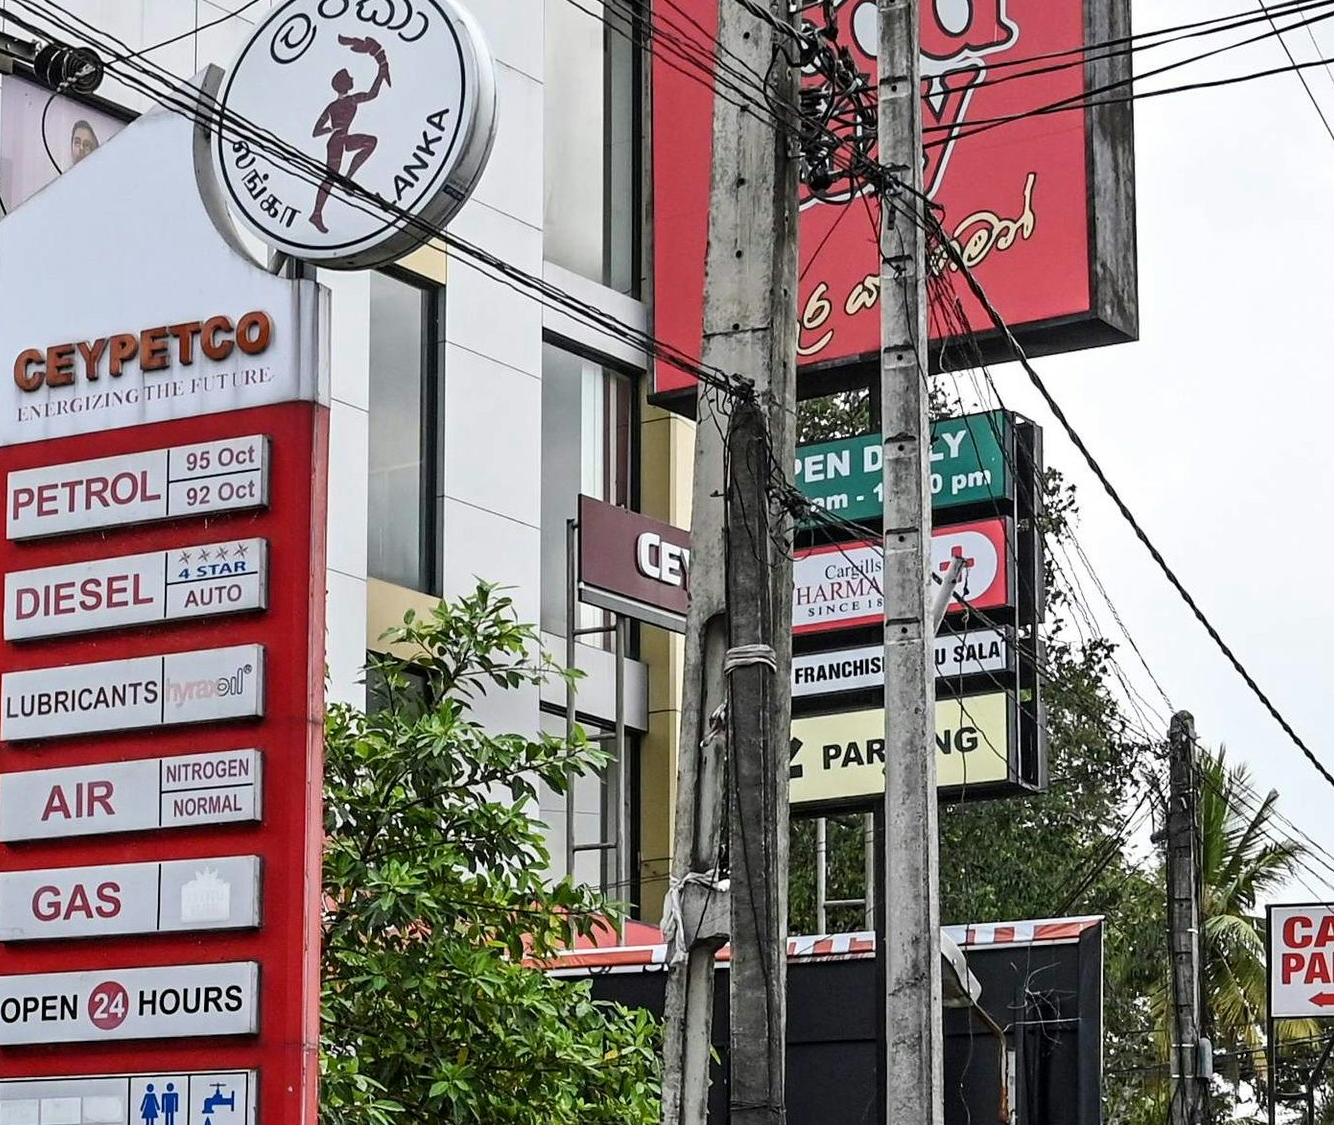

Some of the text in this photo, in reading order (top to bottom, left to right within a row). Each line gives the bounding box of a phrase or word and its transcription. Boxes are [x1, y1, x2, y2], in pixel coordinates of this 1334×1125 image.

[14, 310, 274, 392] CEYPETCO
[17, 366, 273, 423] ENERGIZING THE FUTURE
[13, 445, 255, 520] PETROL 95 Oct
[186, 480, 255, 506] 92 Oct
[951, 470, 992, 495] pm
[824, 558, 882, 581] Cargills
[16, 561, 248, 621] DIESEL 4 STAR
[184, 584, 242, 609] AUTO
[808, 601, 861, 617] SINCE
[953, 641, 1000, 663] SALA
[6, 681, 158, 718] LUBRICANTS
[41, 758, 249, 822] AIR NITROGEN
[173, 794, 243, 818] NORMAL
[32, 882, 122, 922] GAS
[0, 985, 243, 1024] OPEN 24 HOURS
